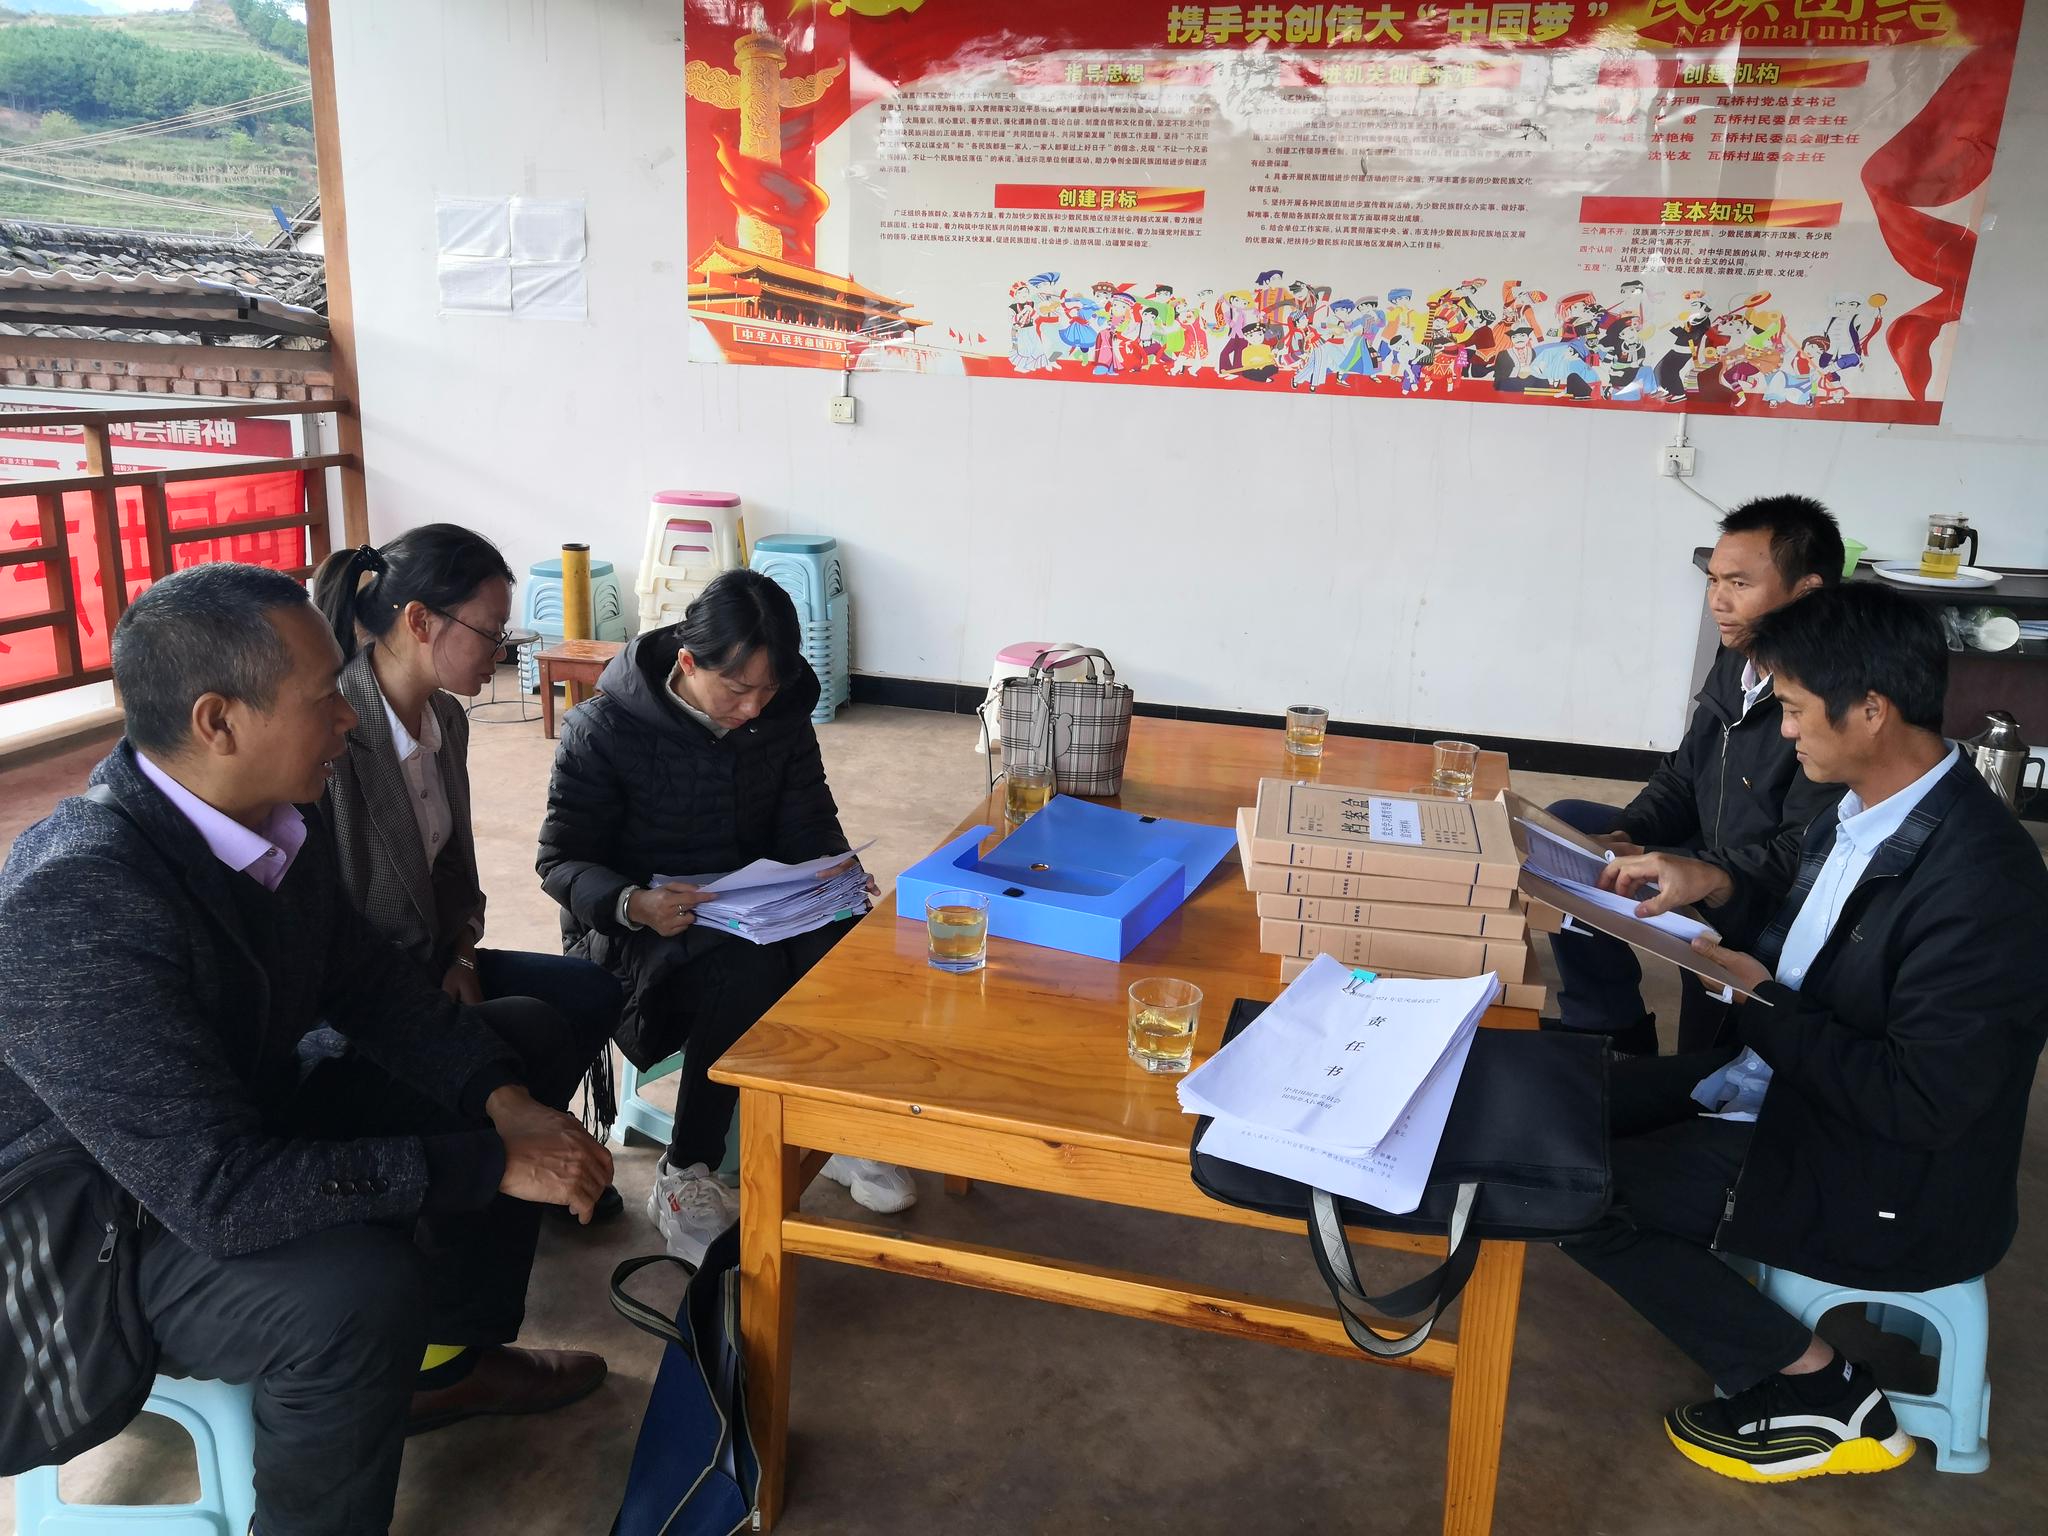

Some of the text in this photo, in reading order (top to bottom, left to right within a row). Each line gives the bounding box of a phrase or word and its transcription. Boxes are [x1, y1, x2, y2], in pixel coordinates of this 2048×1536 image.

[1674, 21, 1903, 46] National unity
[1064, 63, 1145, 83] 指导思想
[1682, 63, 1780, 84] 创建机构
[1716, 95, 1836, 107] 瓦桥村党总支书记
[1713, 114, 1849, 126] 瓦桥村民委员会主任
[1710, 132, 1861, 145] 瓦桥村民委员会副主任
[1708, 150, 1826, 163] 瓦桥村监委会主任
[1058, 189, 1138, 209] 创建目标
[1661, 201, 1755, 223] 基本知识
[742, 329, 842, 350] 中华人民共和国万岁
